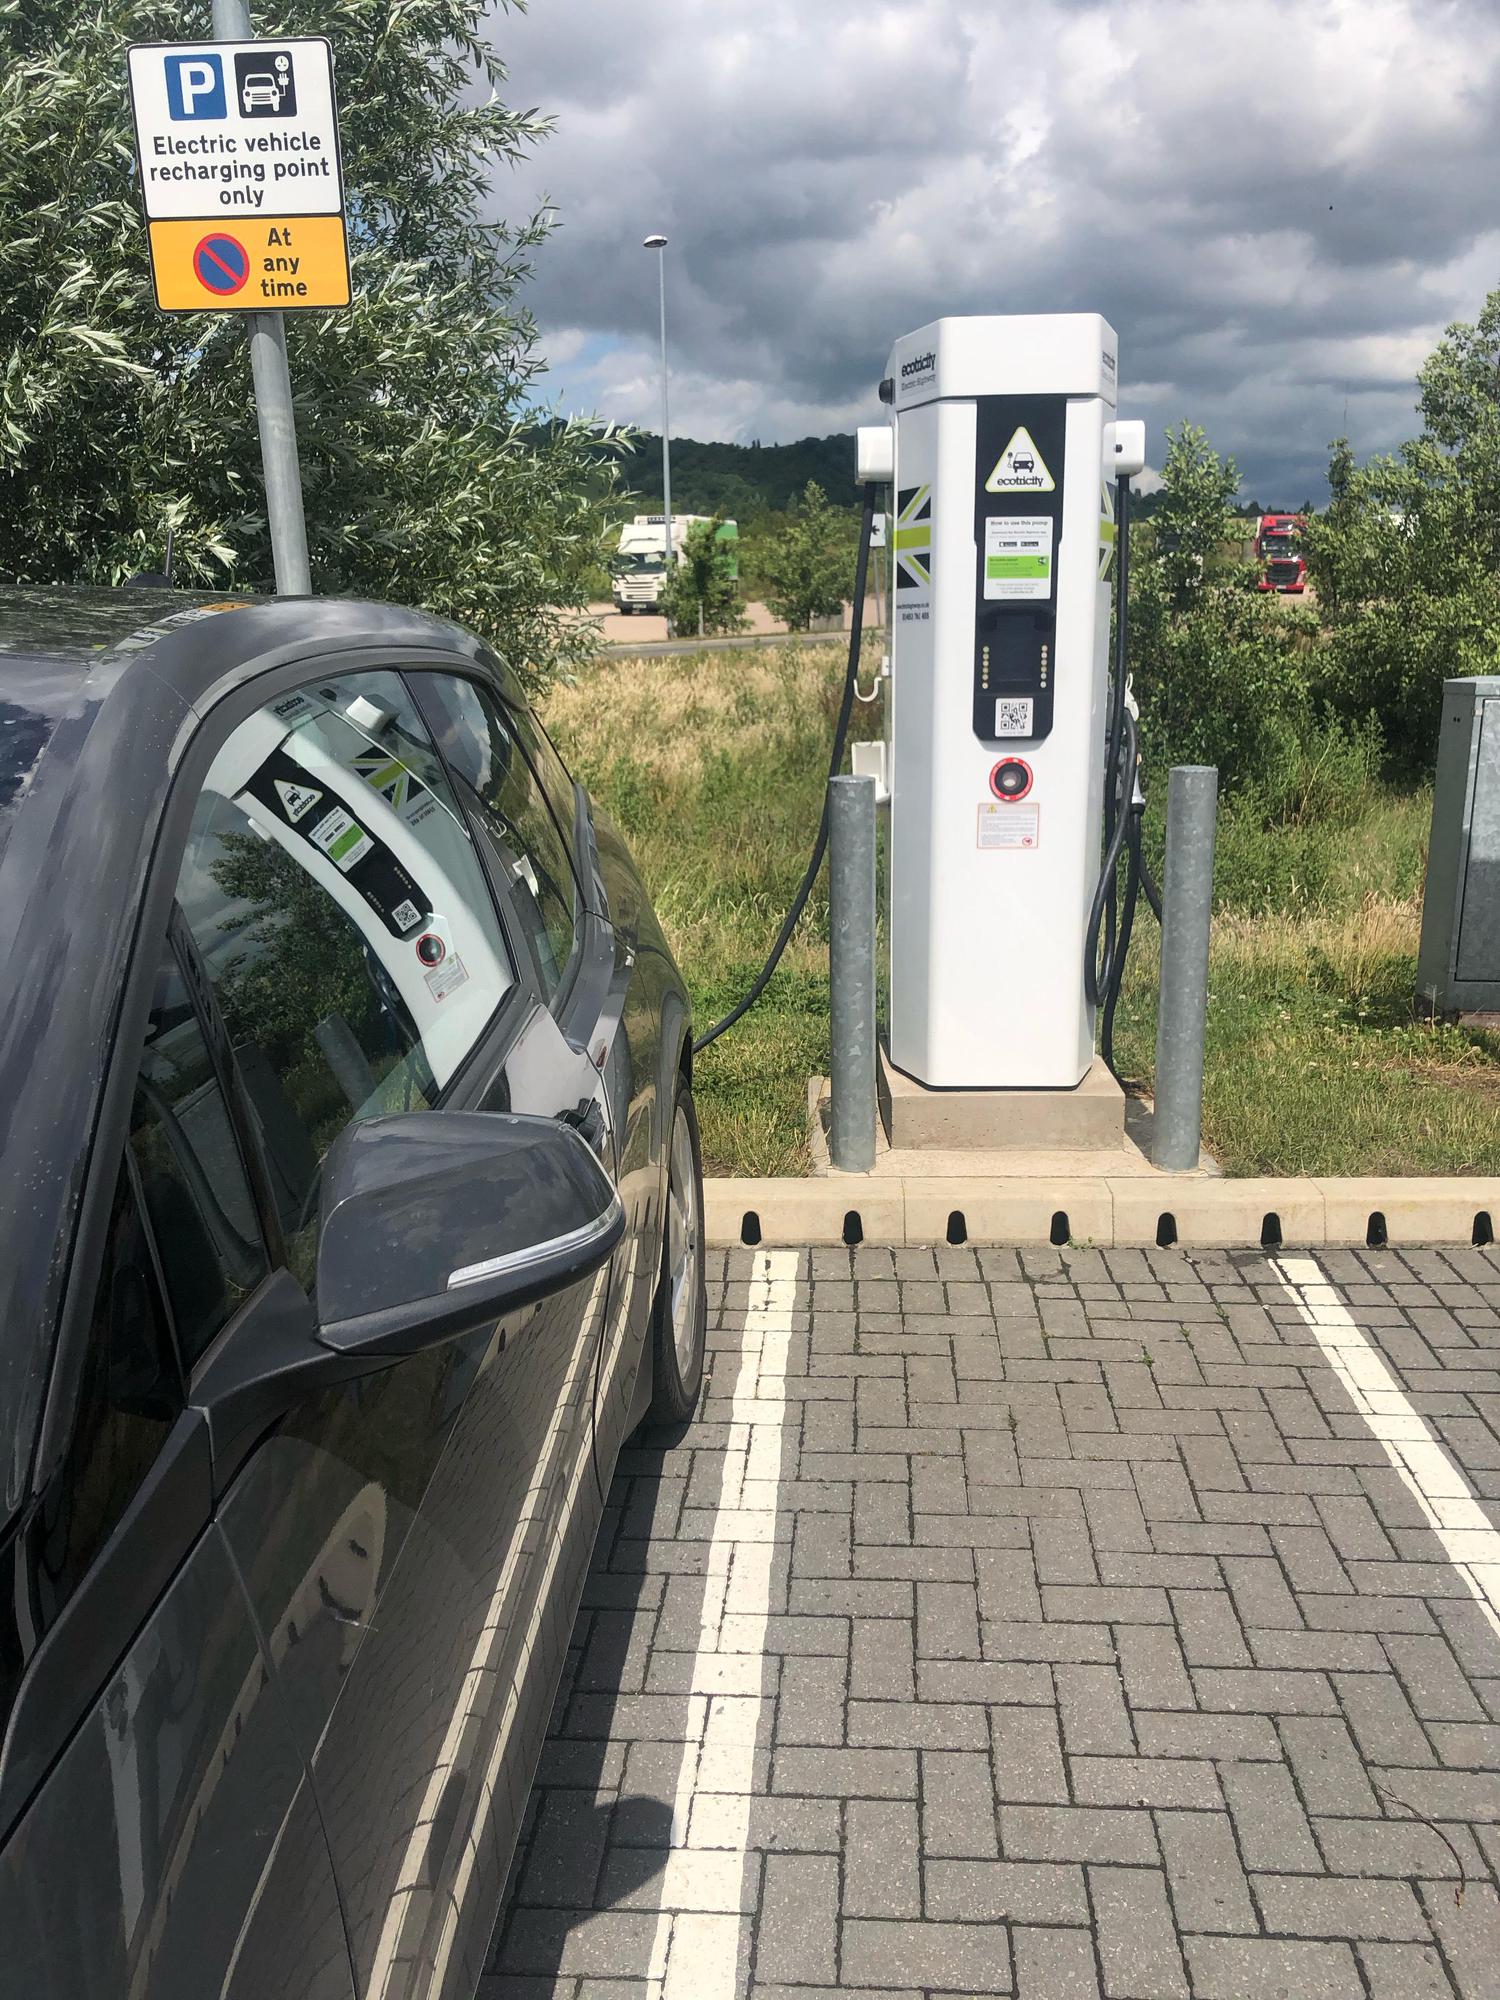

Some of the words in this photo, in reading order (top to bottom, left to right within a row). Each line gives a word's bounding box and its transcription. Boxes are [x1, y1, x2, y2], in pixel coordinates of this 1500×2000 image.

[178, 61, 216, 115] P
[152, 133, 237, 156] Electric
[245, 131, 322, 153] vehicle
[149, 159, 266, 183] recharging
[274, 157, 330, 181] point
[219, 185, 265, 208] only
[267, 227, 293, 248] At
[263, 256, 300, 275] any
[260, 278, 308, 298] time
[901, 352, 936, 377] ecotricity
[997, 476, 1044, 487] ecotricity
